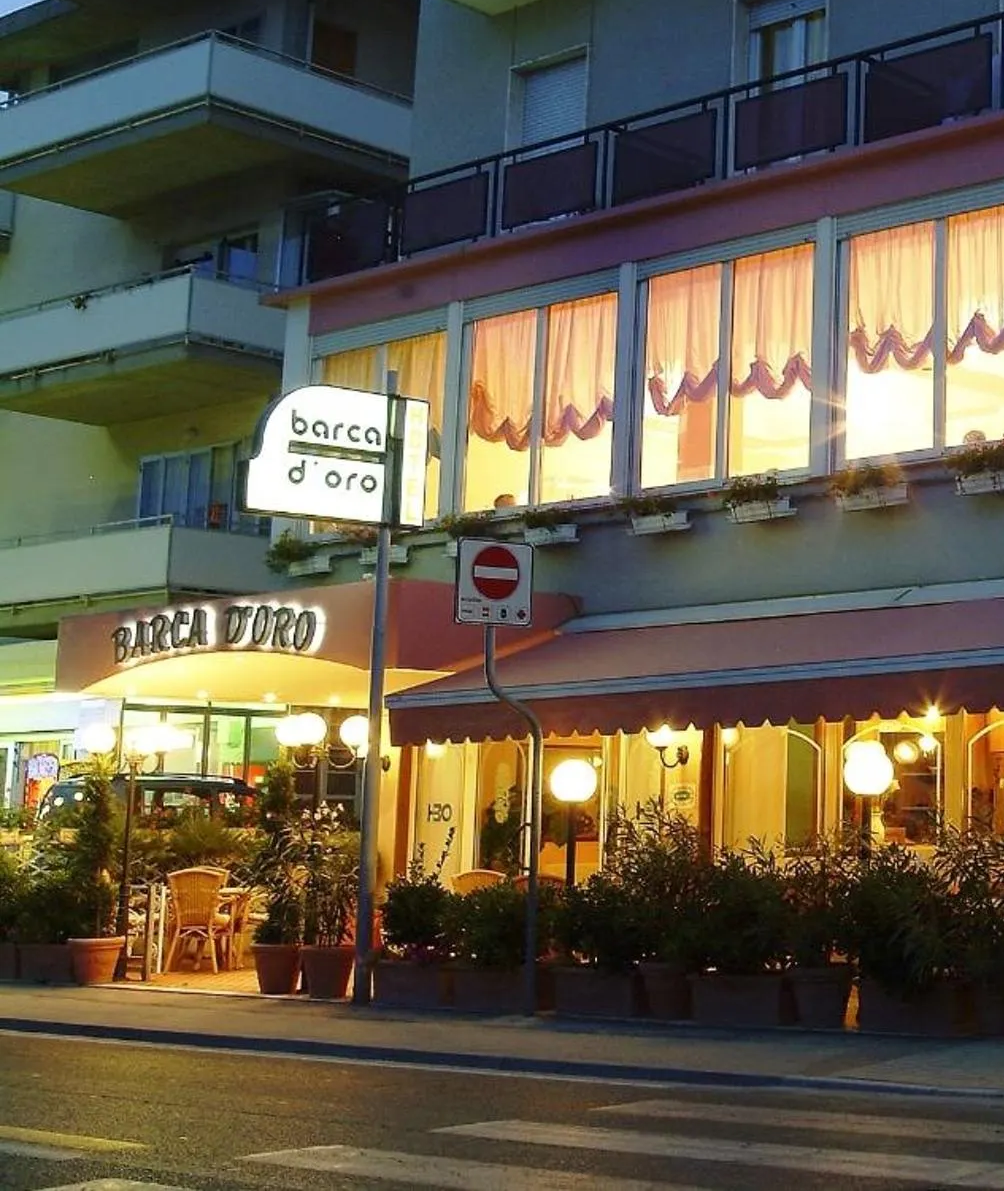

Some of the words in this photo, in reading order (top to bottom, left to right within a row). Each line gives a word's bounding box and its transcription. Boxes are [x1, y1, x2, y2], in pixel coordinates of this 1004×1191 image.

[291, 409, 382, 446] barca
[288, 459, 377, 493] d'oro
[112, 608, 209, 664] BARCA
[225, 605, 317, 651] D'ORO
